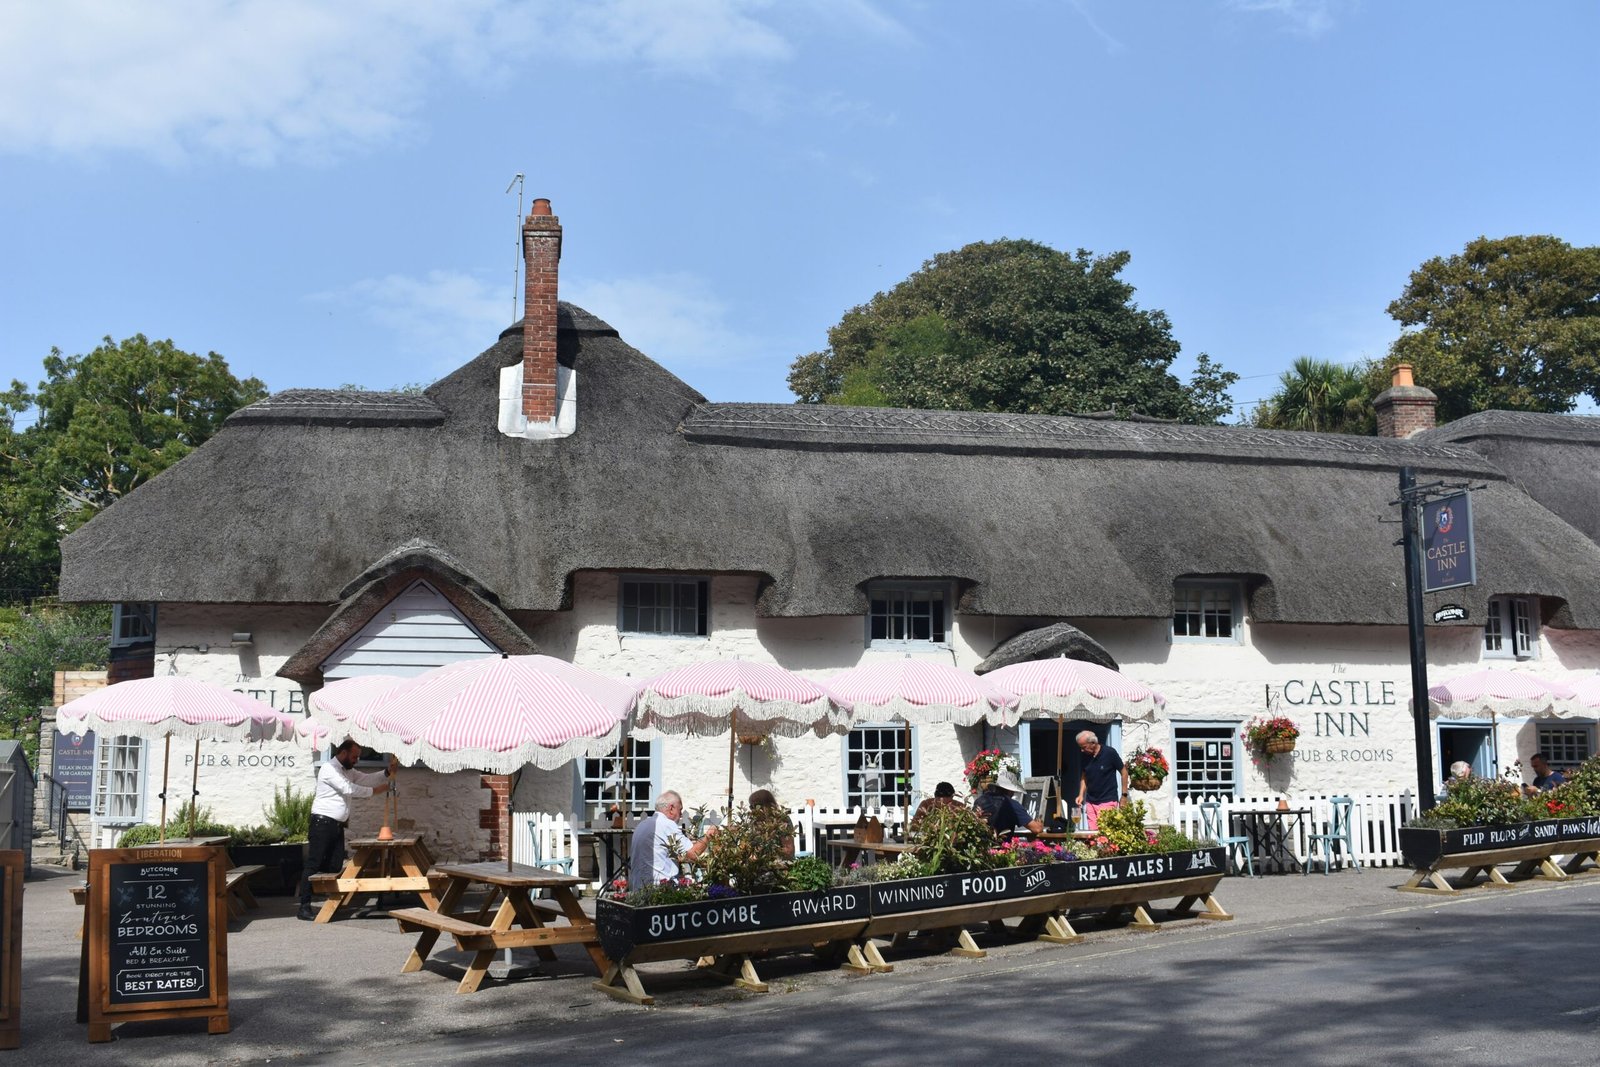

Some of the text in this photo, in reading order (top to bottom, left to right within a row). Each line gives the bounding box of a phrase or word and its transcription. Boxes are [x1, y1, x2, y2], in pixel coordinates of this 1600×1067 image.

[1427, 541, 1466, 560] CASTLE
[1437, 557, 1457, 571] INN
[1331, 663, 1347, 674] The
[235, 673, 251, 683] The
[1283, 679, 1396, 706] CASTLE
[1314, 712, 1370, 737] INN
[184, 754, 296, 767] PUB & ROOMS
[1292, 749, 1394, 762] PUB & ROOMS
[1463, 832, 1485, 846] FLIP
[1490, 829, 1516, 843] FLOPS
[1534, 824, 1558, 838] SANDY
[136, 849, 182, 860] LIBERATION
[140, 866, 178, 876] BUTCOMBE
[146, 884, 168, 900] 12
[649, 904, 760, 937] BUTCOMBE
[962, 875, 1007, 896] FOOD
[1025, 869, 1046, 888] AND
[1078, 863, 1118, 882] REAL
[120, 911, 194, 924] boutique
[117, 923, 198, 937] BEDROOMS
[129, 946, 147, 956] All
[149, 956, 191, 964] BREAKFAST
[125, 978, 197, 991] BEST RATES!
